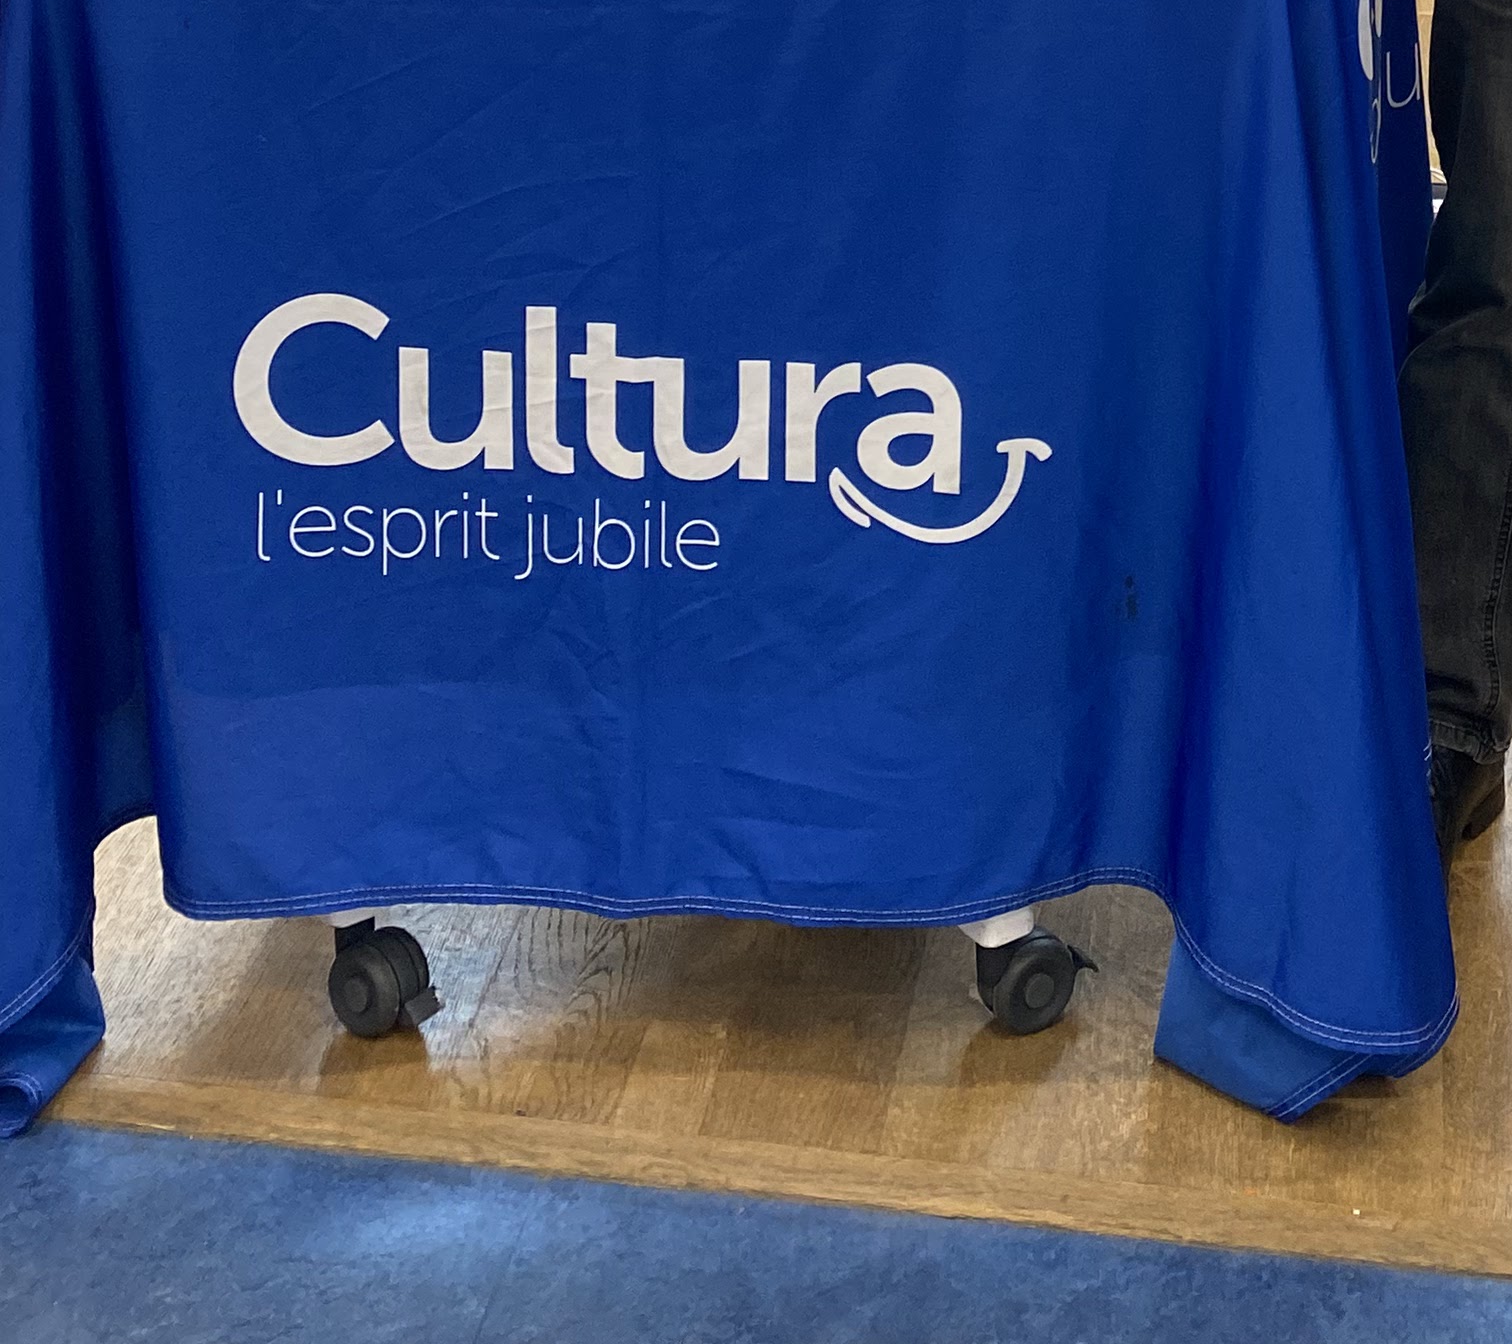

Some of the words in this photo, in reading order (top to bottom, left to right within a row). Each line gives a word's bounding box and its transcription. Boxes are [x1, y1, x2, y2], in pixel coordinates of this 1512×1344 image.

[232, 292, 1052, 545] Cultura
[257, 490, 501, 576] l'esprit
[514, 494, 721, 581] jubile
